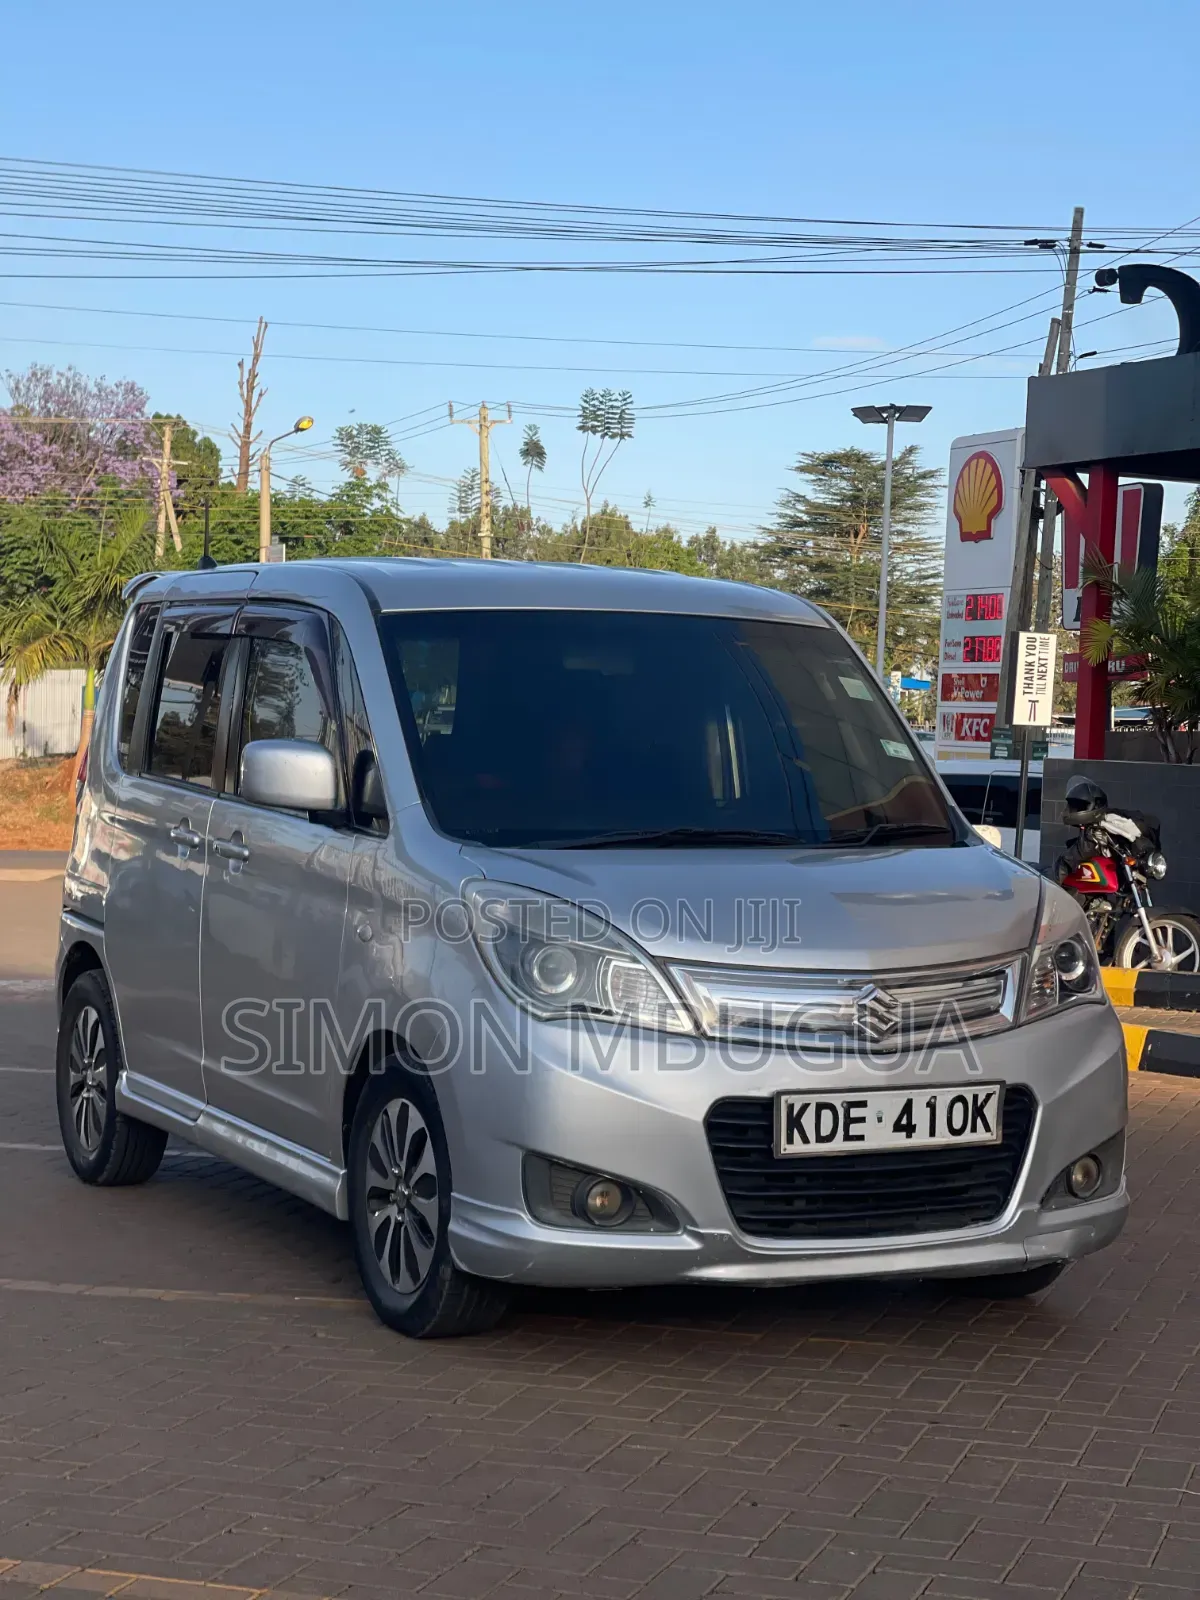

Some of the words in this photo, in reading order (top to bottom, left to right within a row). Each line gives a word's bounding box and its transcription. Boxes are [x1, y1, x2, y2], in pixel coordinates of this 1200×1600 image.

[1025, 636, 1037, 658] YOU
[1039, 635, 1050, 655] TIME
[1022, 660, 1036, 696] THANK
[1037, 656, 1049, 681] NEXT
[953, 686, 983, 699] V-Power
[1035, 682, 1047, 696] TILL
[961, 717, 990, 737] KFC
[786, 1099, 868, 1145] KDE
[892, 1092, 994, 1139] 410K
